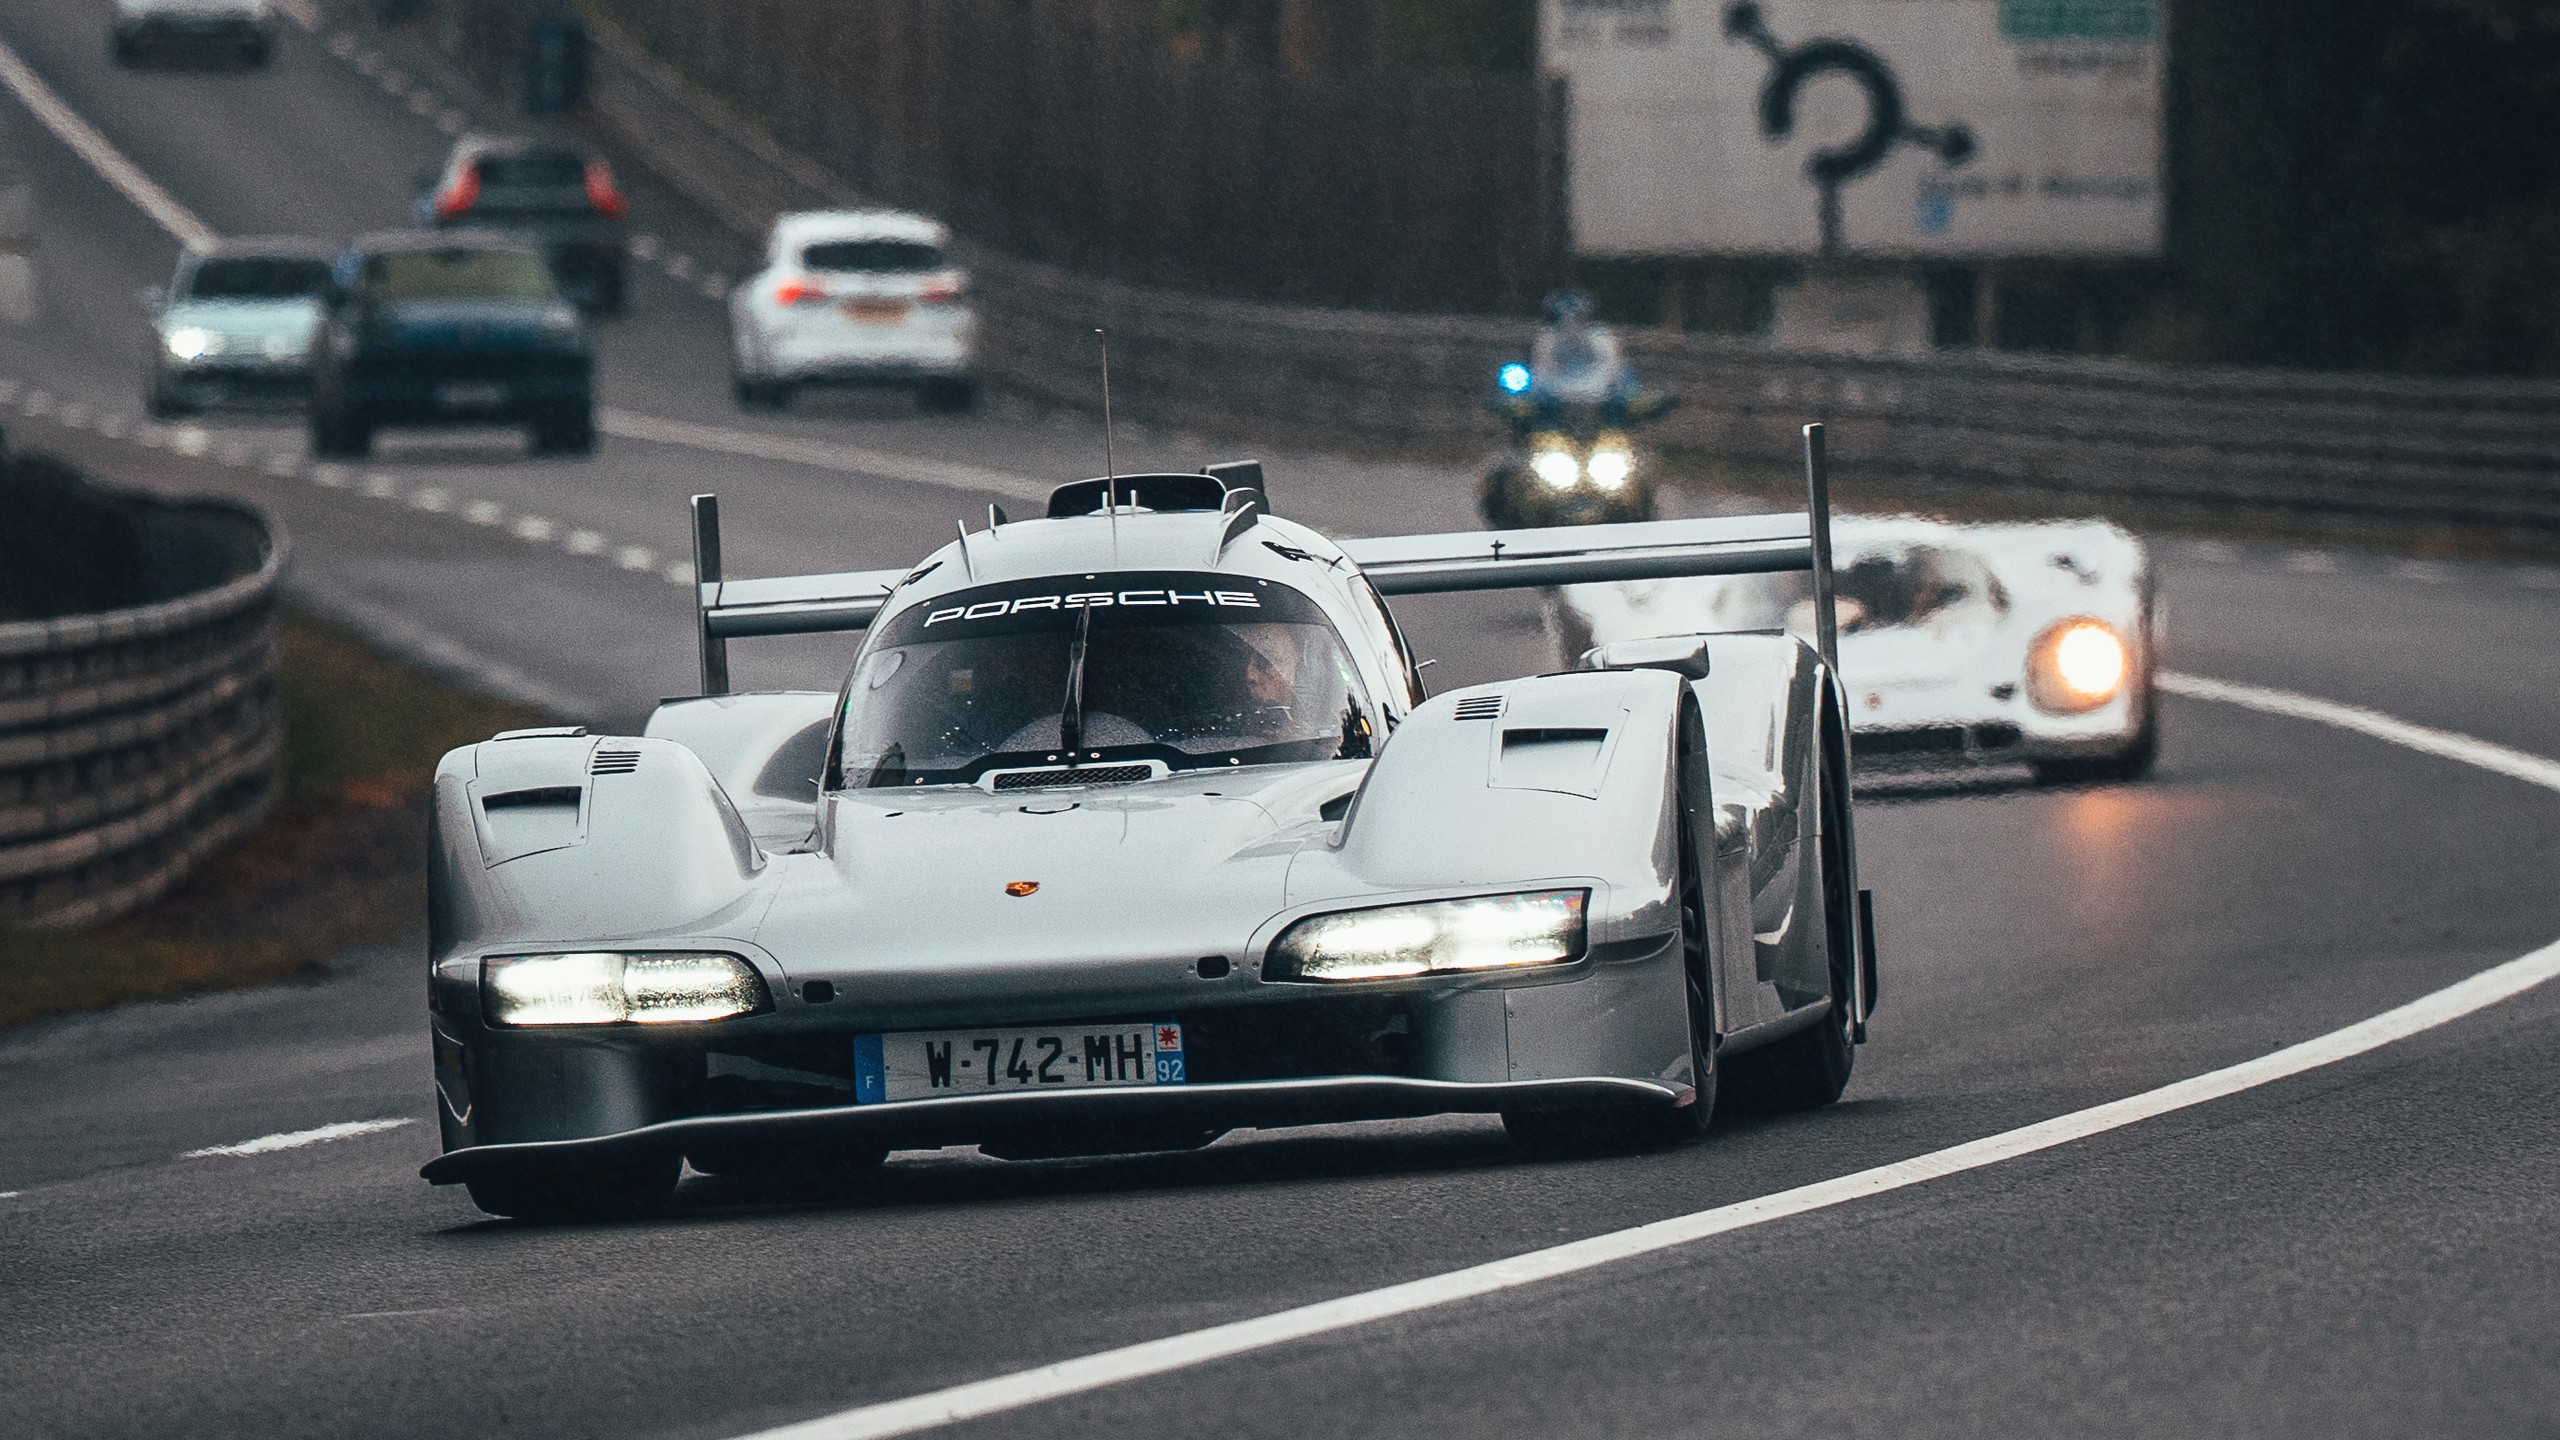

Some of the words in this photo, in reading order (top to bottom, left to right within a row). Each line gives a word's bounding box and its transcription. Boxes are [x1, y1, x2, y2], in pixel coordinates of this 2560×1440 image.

[924, 590, 1262, 628] PORSCHE
[925, 1033, 1145, 1088] W-742-MH
[1157, 1059, 1184, 1082] 92
[865, 1075, 875, 1089] F
